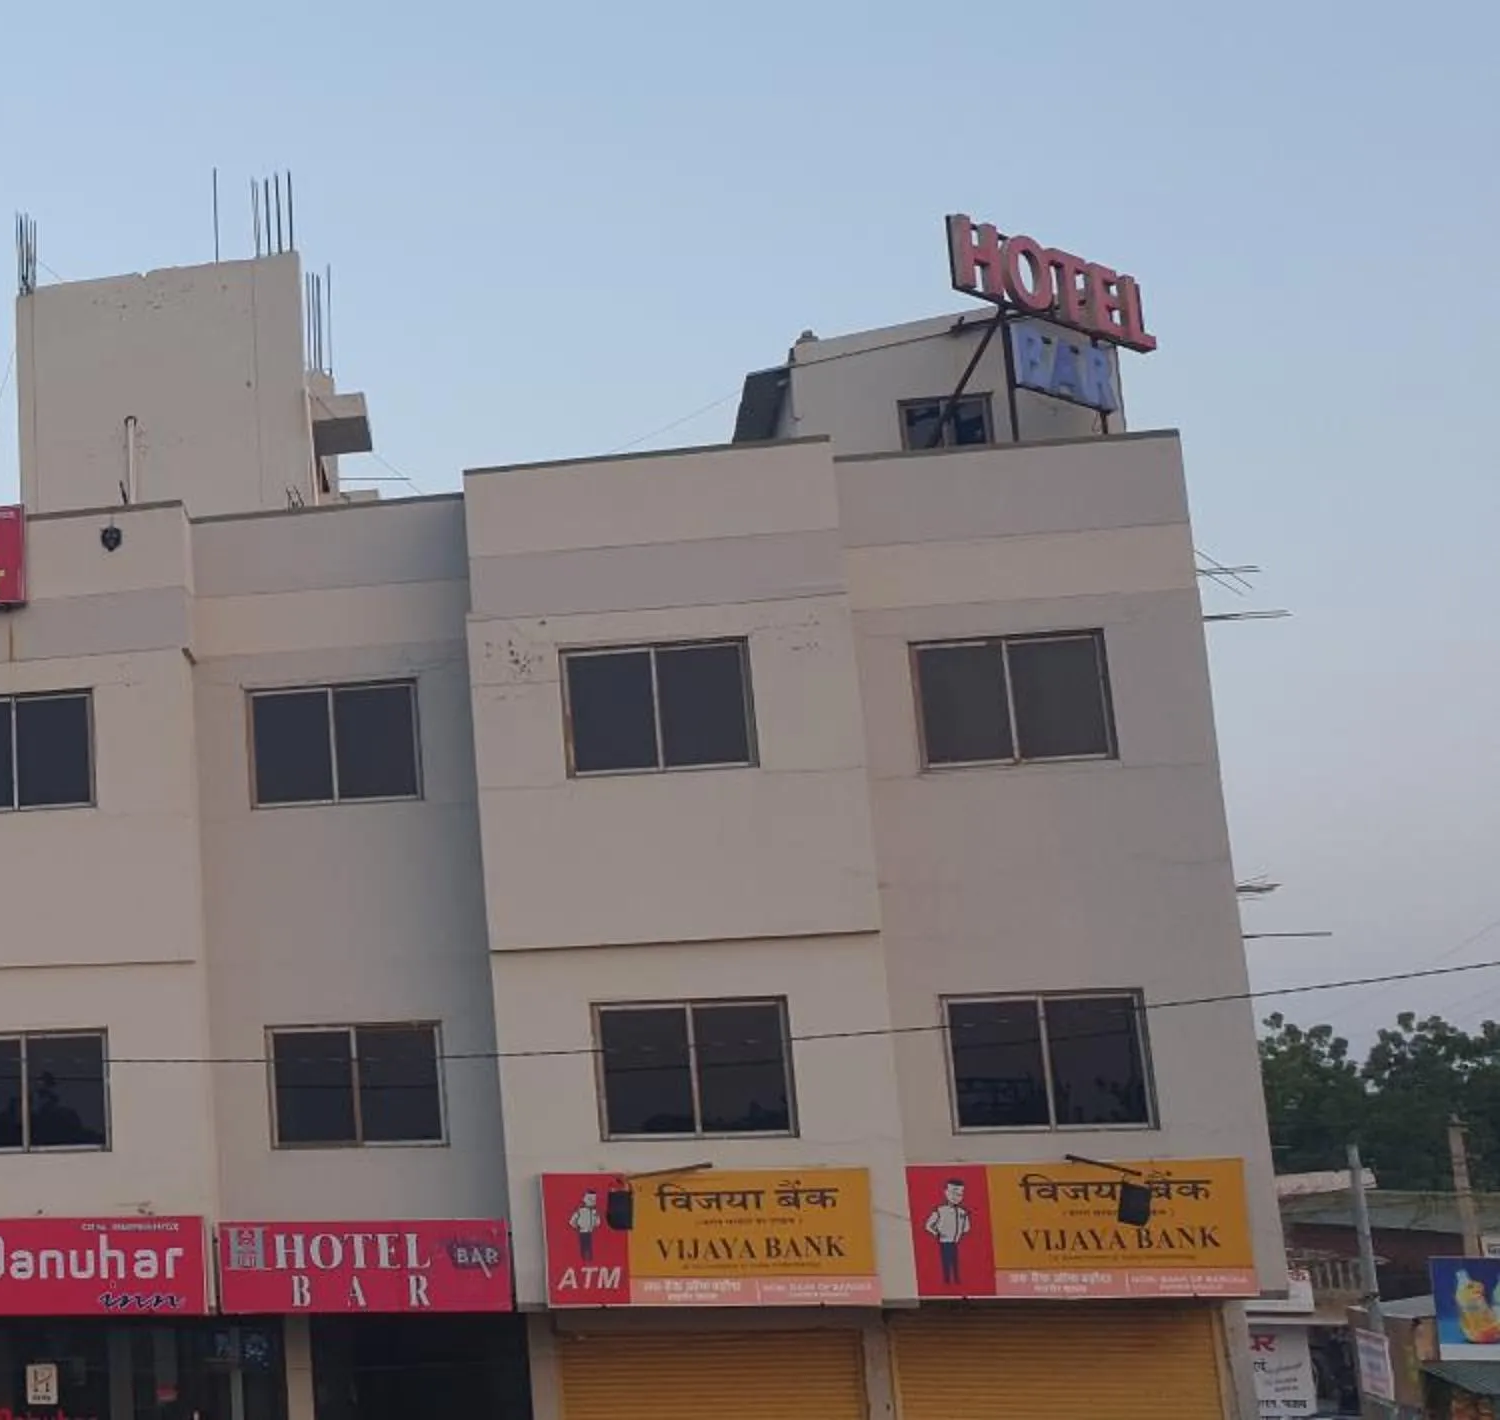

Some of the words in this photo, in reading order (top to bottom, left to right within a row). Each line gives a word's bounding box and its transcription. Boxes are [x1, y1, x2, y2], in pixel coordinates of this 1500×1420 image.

[946, 214, 1157, 353] HOTEL
[1013, 324, 1118, 413] BAR
[655, 1183, 765, 1213] विजया
[774, 1179, 839, 1210] बैंक
[1019, 1173, 1124, 1201] विजय
[274, 1232, 431, 1270] HOTEL
[657, 1237, 757, 1260] VIJAYA
[765, 1234, 846, 1258] BANK
[1021, 1228, 1126, 1250] VIJAYA
[1137, 1226, 1221, 1249] BANK
[457, 1246, 500, 1265] BAR
[558, 1266, 622, 1292] ATM
